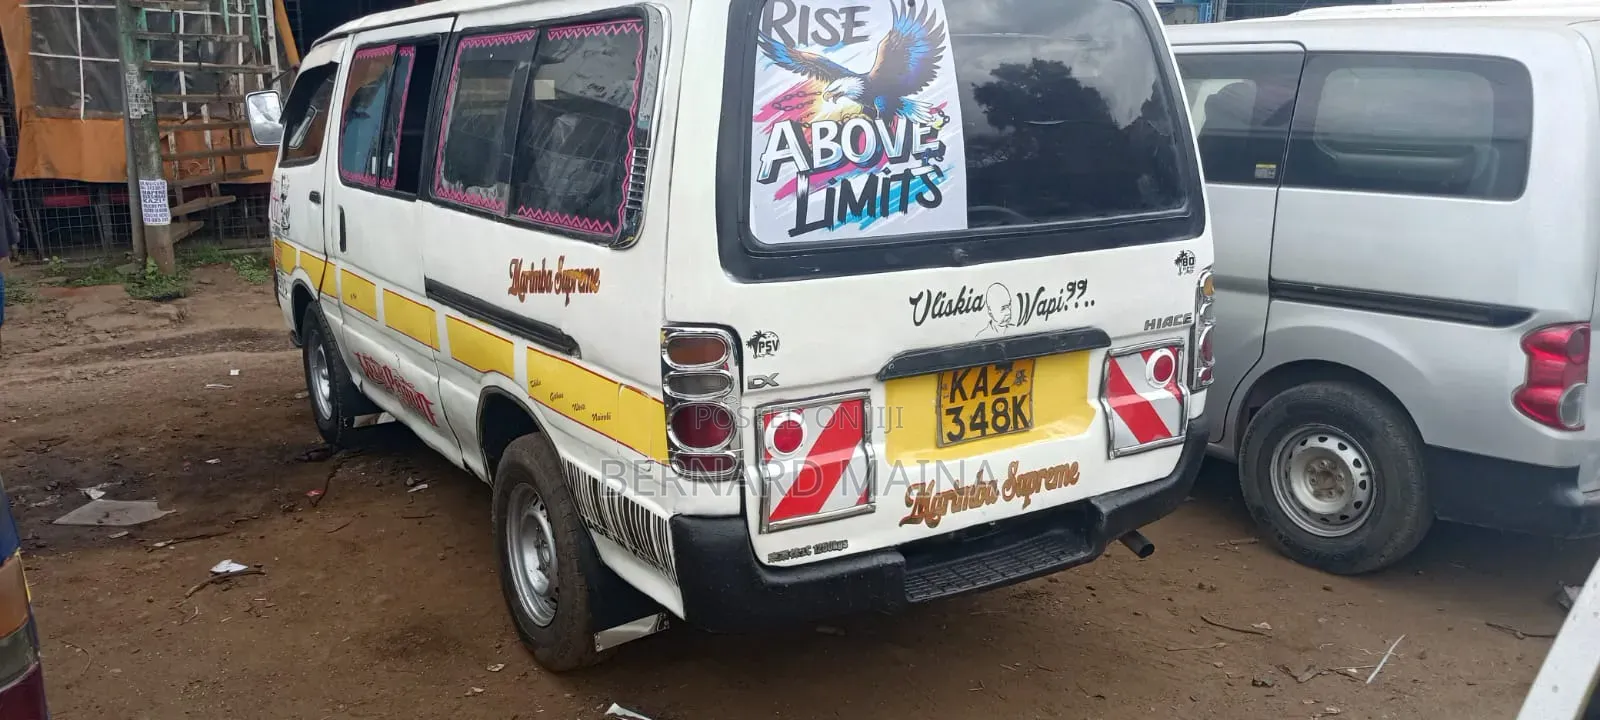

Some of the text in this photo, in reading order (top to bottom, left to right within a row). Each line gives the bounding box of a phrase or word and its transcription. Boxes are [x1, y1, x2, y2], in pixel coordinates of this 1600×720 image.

[763, 0, 872, 49] RISE
[757, 115, 946, 184] ABOVE
[508, 255, 600, 307] Marimba Supreme
[758, 339, 780, 353] PSV
[1143, 312, 1193, 331] HIACE
[747, 372, 780, 390] DX
[949, 361, 1013, 404] KAZ
[945, 394, 1030, 443] 348K
[899, 460, 1080, 528] Marimba Supreme
